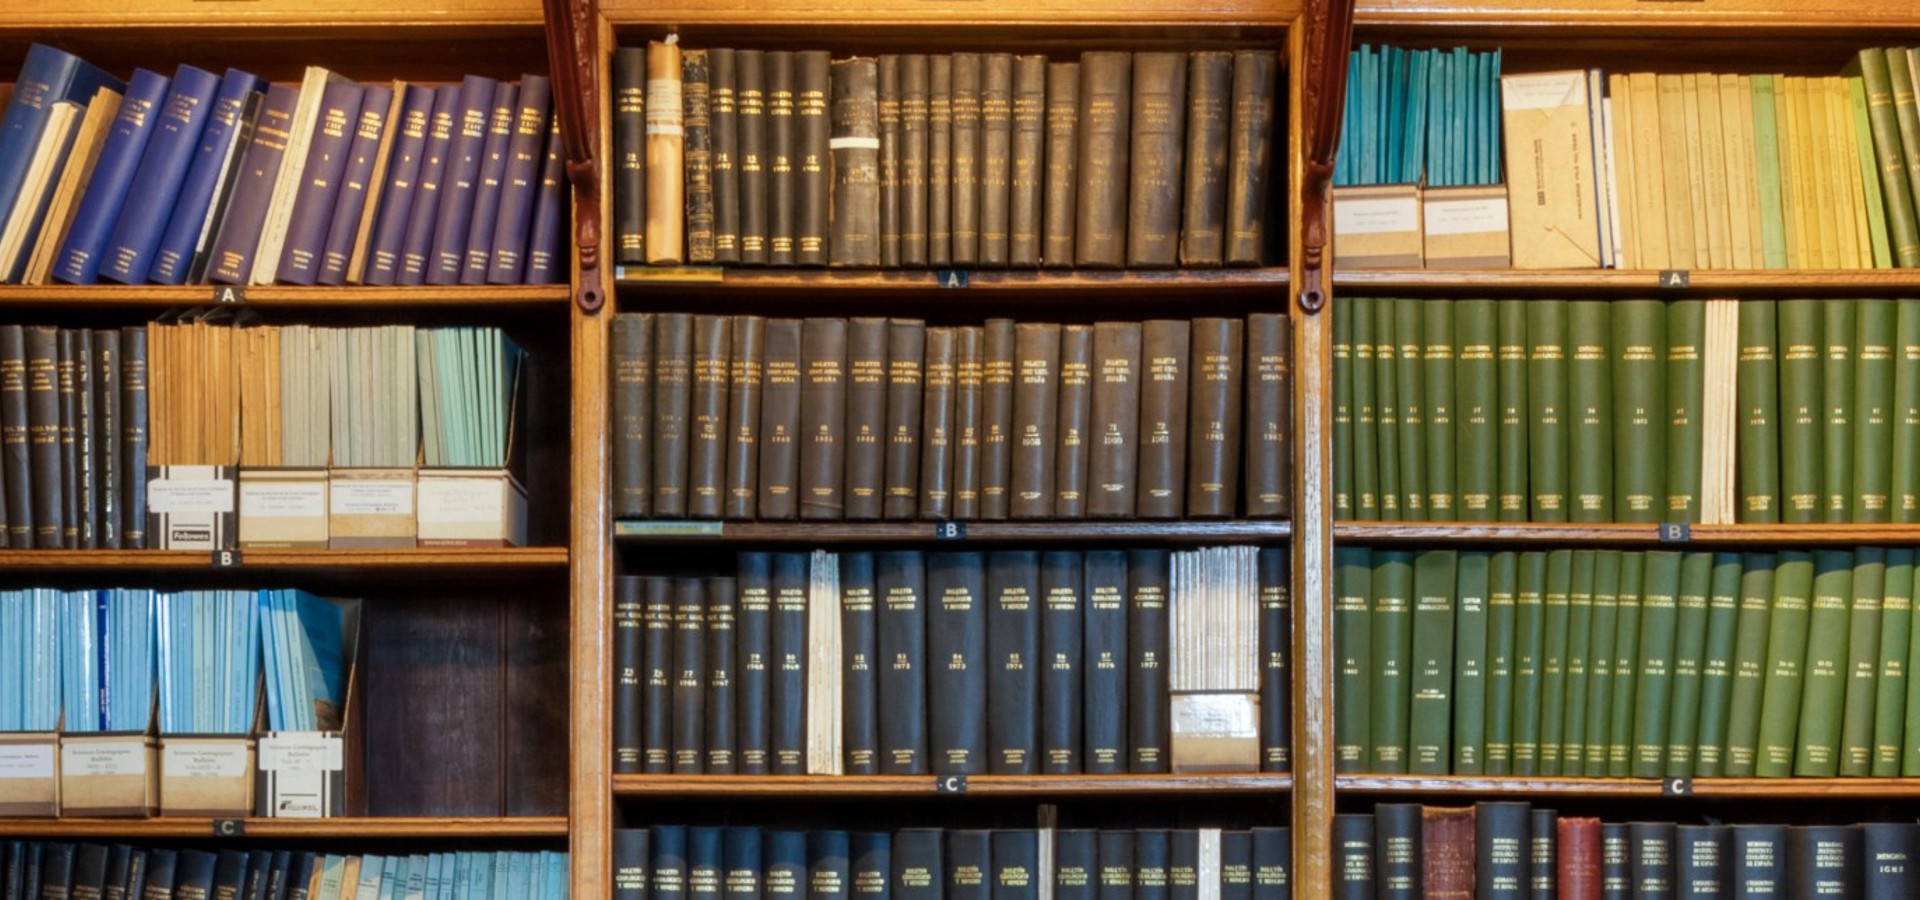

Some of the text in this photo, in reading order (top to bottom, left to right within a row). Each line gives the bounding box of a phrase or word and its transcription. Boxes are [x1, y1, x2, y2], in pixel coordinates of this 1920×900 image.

[947, 274, 959, 287] A
[1669, 273, 1682, 285] A
[222, 287, 235, 302] A
[946, 523, 957, 537] B
[1668, 524, 1682, 540] B
[221, 552, 232, 565] B
[946, 777, 957, 791] C
[1671, 779, 1684, 794] C
[221, 821, 234, 834] C
